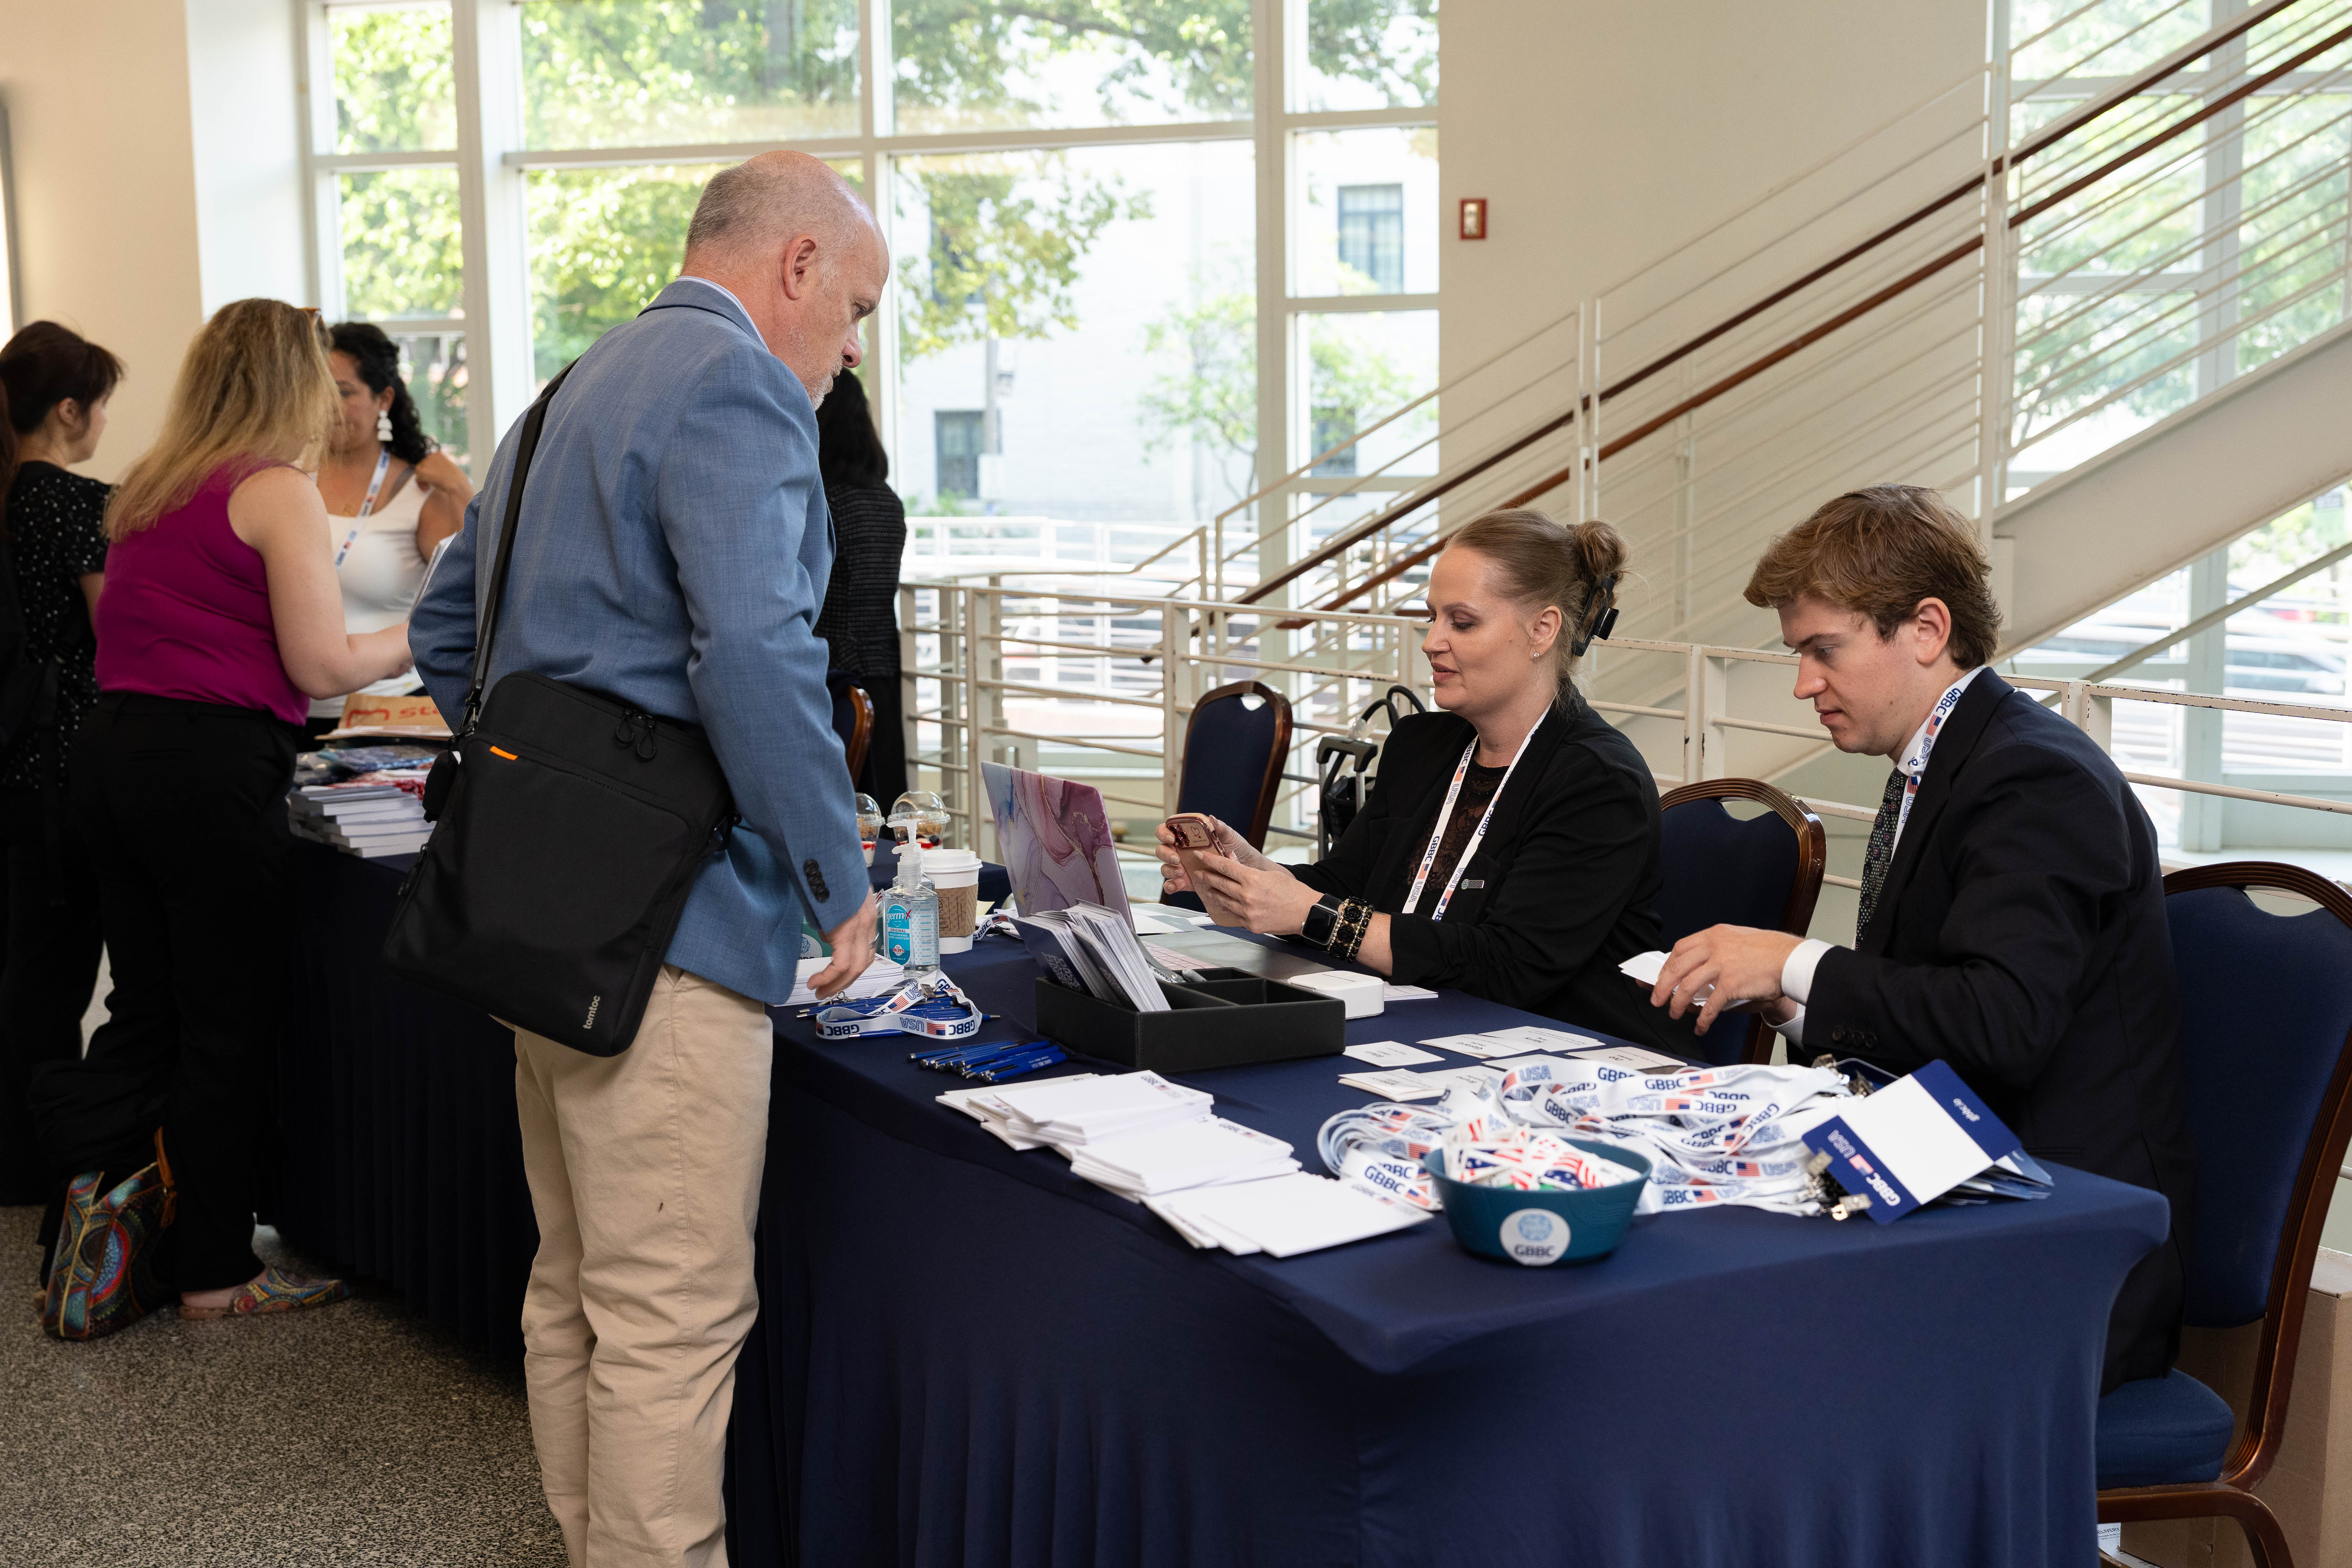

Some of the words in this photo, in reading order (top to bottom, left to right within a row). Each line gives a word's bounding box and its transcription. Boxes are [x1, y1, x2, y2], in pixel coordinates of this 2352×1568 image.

[1936, 688, 1962, 715] GBBC
[1461, 740, 1476, 765] GBBC
[1446, 784, 1459, 805] USA
[1425, 836, 1440, 862] GBBC
[1449, 867, 1465, 889] USA
[1409, 881, 1423, 903] USA
[905, 987, 921, 1000] US
[583, 996, 601, 1029] tomtoc
[826, 1024, 860, 1036] GBBC
[900, 1017, 924, 1032] USA
[949, 1020, 975, 1035] GBBC
[1520, 1065, 1552, 1081] USA
[1598, 1066, 1635, 1082] GBB
[1645, 1078, 1686, 1090] GBBC
[1545, 1099, 1573, 1124] GBBC
[1628, 1097, 1662, 1110] USA
[1695, 1100, 1736, 1113] GBBC
[1827, 1129, 1856, 1159] USA
[1364, 1166, 1405, 1194] GBBC
[1866, 1172, 1901, 1207] GBBC
[1514, 1244, 1555, 1258] GBBC
